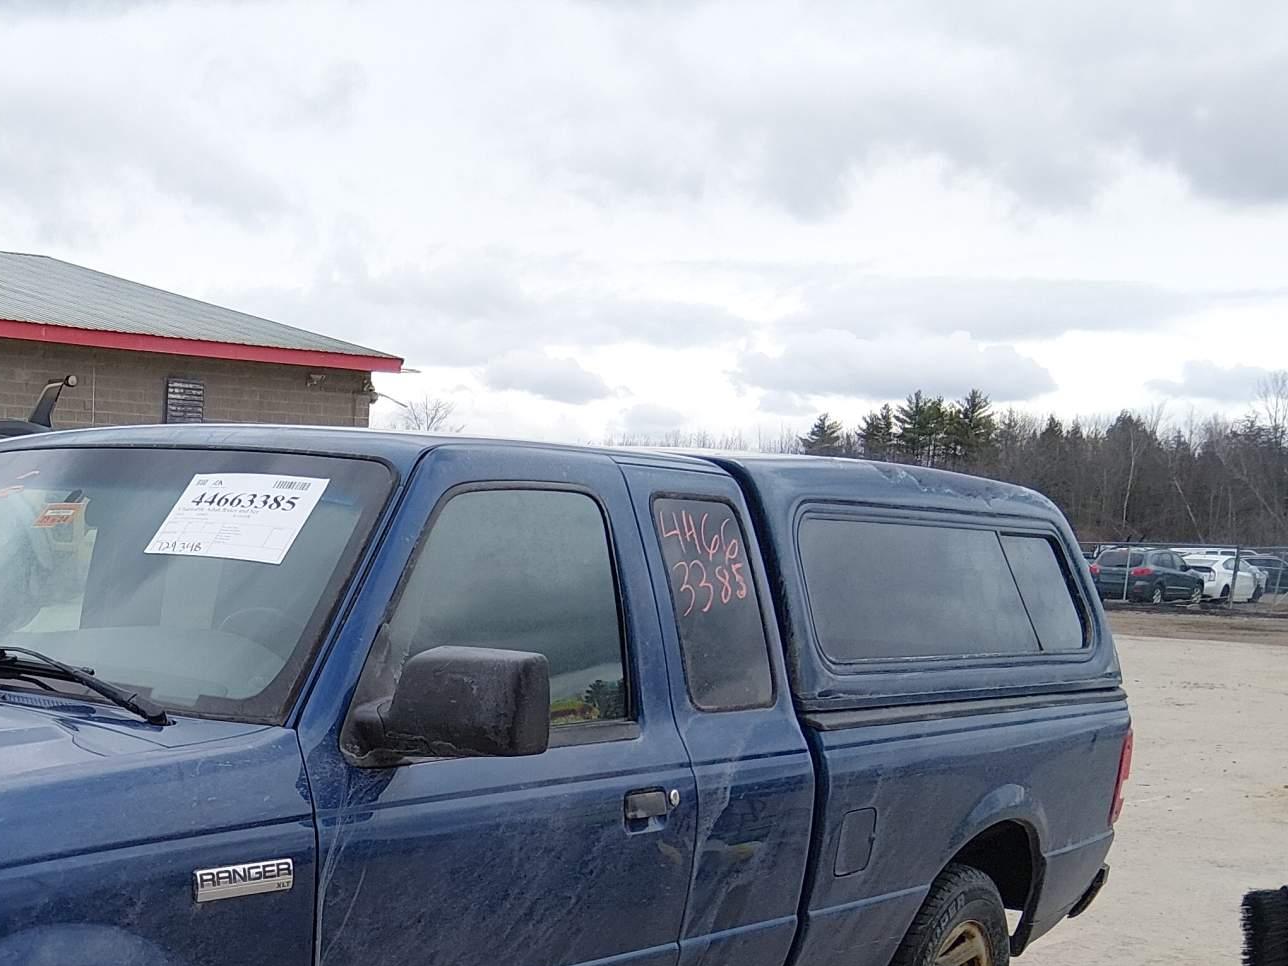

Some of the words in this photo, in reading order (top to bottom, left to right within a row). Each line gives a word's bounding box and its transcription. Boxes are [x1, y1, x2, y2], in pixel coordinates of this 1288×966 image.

[191, 491, 300, 512] 44663385
[659, 510, 740, 563] 4466
[673, 559, 747, 617] 3385
[199, 861, 292, 889] RANGER
[276, 881, 291, 889] XLT
